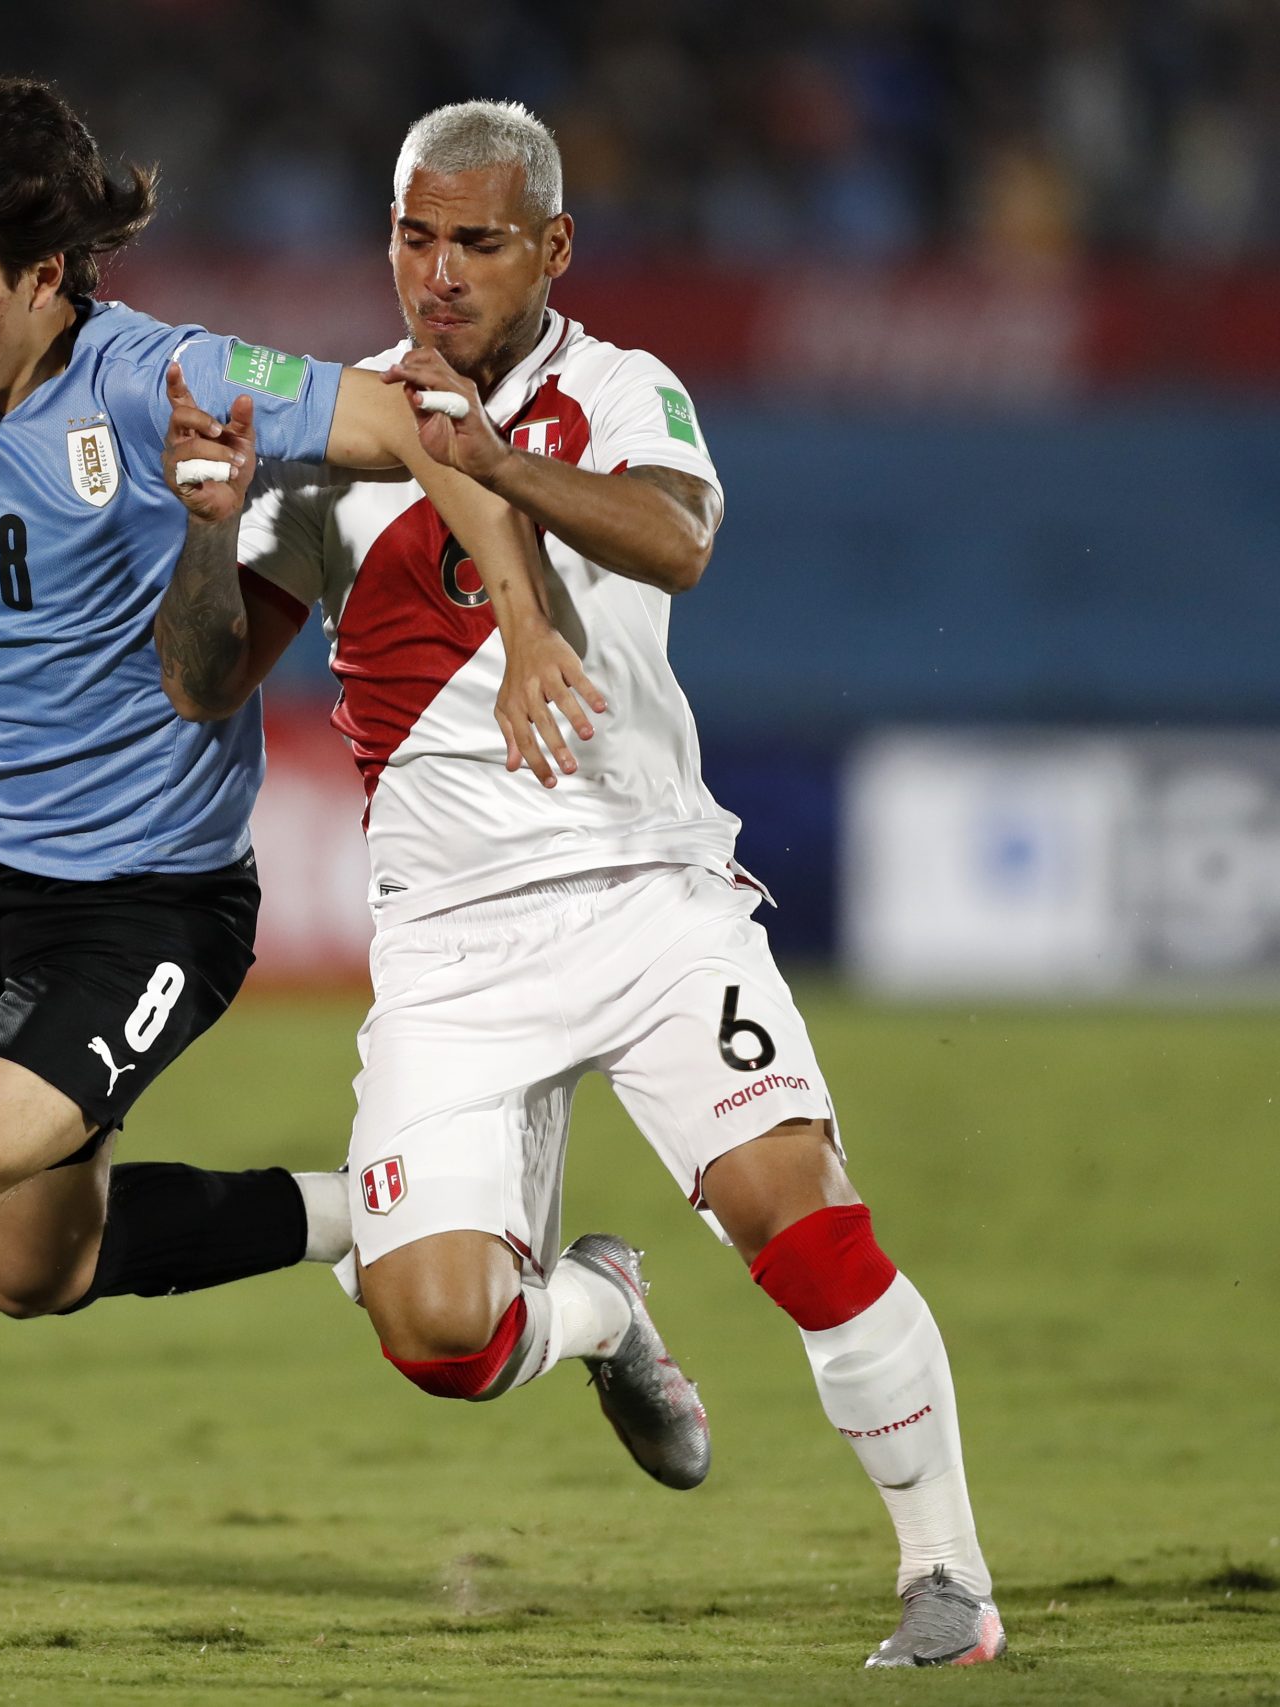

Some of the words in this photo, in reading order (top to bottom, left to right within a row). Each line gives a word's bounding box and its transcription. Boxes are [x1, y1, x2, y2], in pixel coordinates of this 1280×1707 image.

[84, 441, 99, 470] AUF
[124, 961, 186, 1053] 8
[718, 984, 777, 1072] 6
[713, 1073, 811, 1118] marathon
[366, 1174, 398, 1197] FPF
